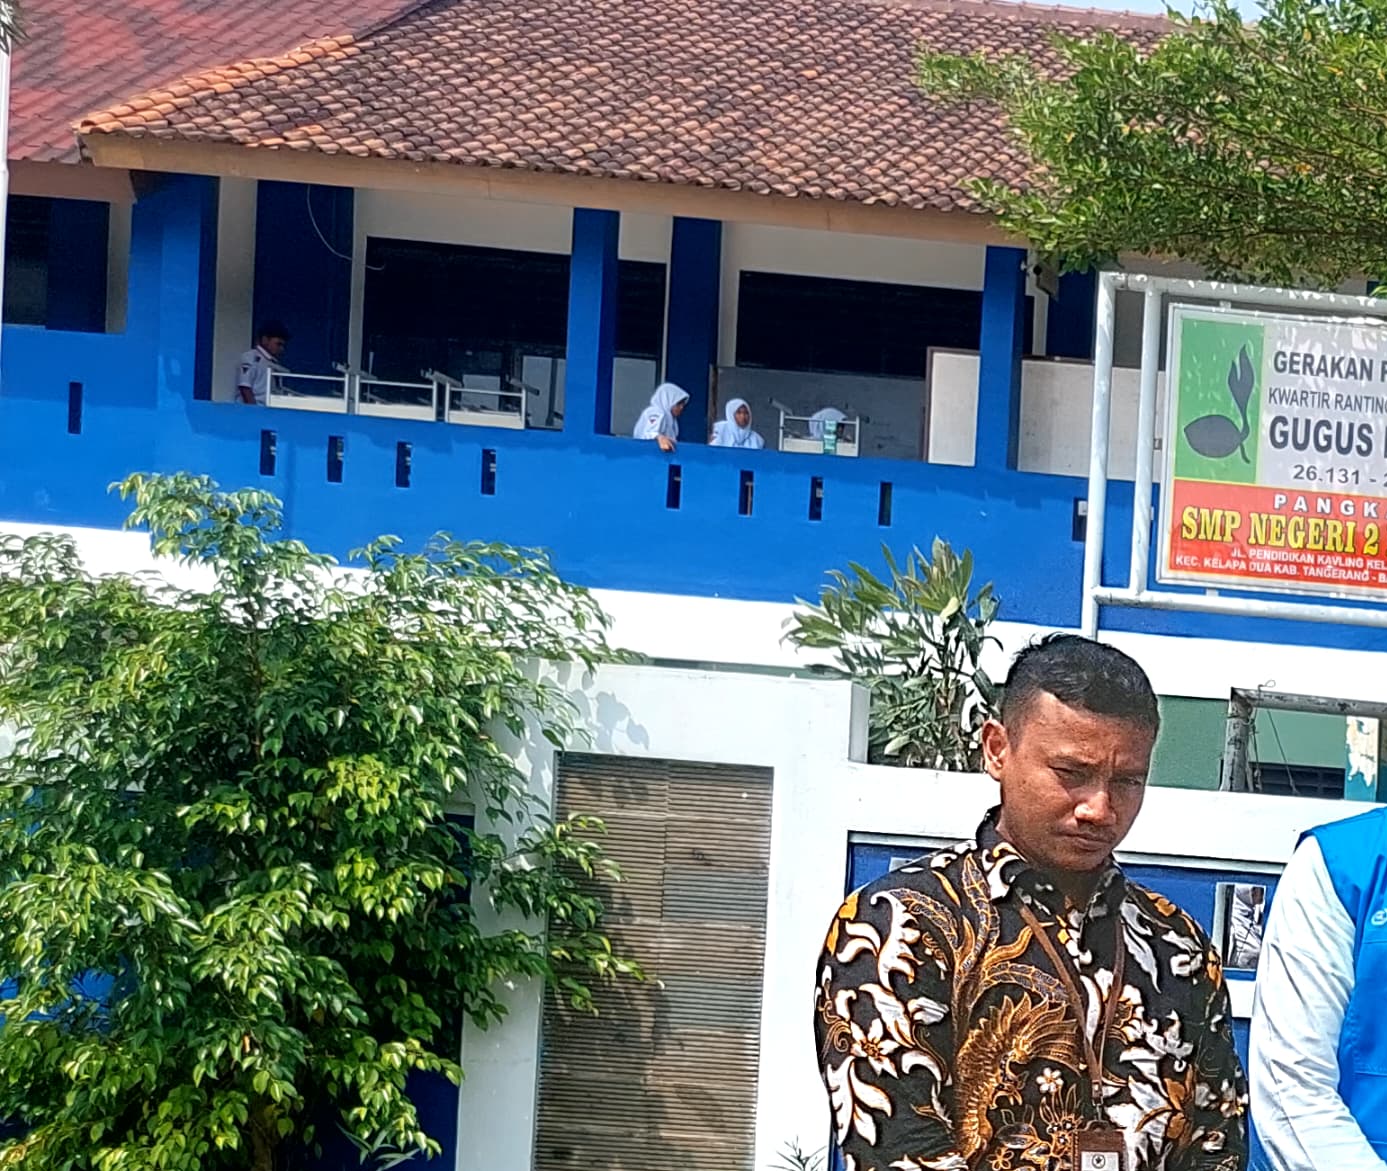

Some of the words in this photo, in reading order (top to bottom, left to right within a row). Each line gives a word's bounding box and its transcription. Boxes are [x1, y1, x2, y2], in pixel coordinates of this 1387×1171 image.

[1273, 350, 1373, 382] GERAKAN
[1268, 387, 1331, 409] KWARTIR
[1269, 415, 1374, 458] GUGUS
[1292, 464, 1361, 485] 26.131
[1181, 506, 1242, 543] SMP
[1248, 512, 1357, 554] NEGERI
[1363, 523, 1380, 556] 2
[1175, 554, 1200, 567] KEC.
[1204, 557, 1247, 571] KELAPA
[1249, 561, 1272, 573] DUA
[1274, 565, 1300, 577] KAB.
[1303, 566, 1370, 582] TANGERANG
[1249, 549, 1315, 564] PENDIDIKAN
[1317, 555, 1365, 569] KAVLING
